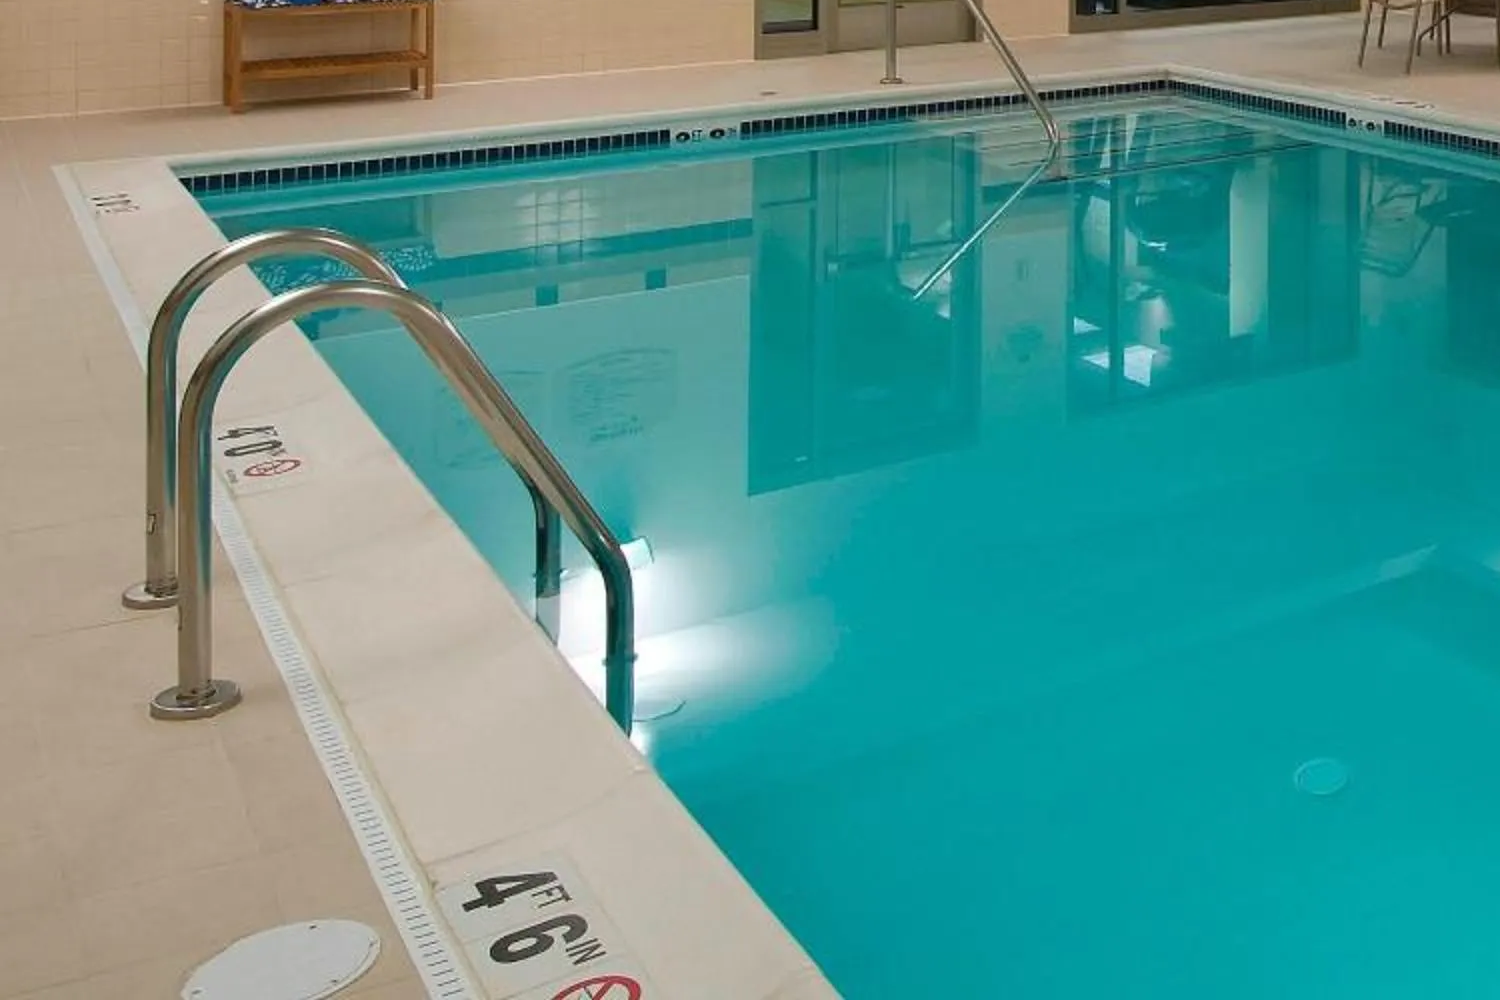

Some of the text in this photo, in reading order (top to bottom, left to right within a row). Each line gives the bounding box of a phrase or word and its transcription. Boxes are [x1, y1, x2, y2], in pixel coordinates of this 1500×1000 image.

[461, 871, 573, 913] 4 FT
[489, 913, 607, 966] 6 IN
